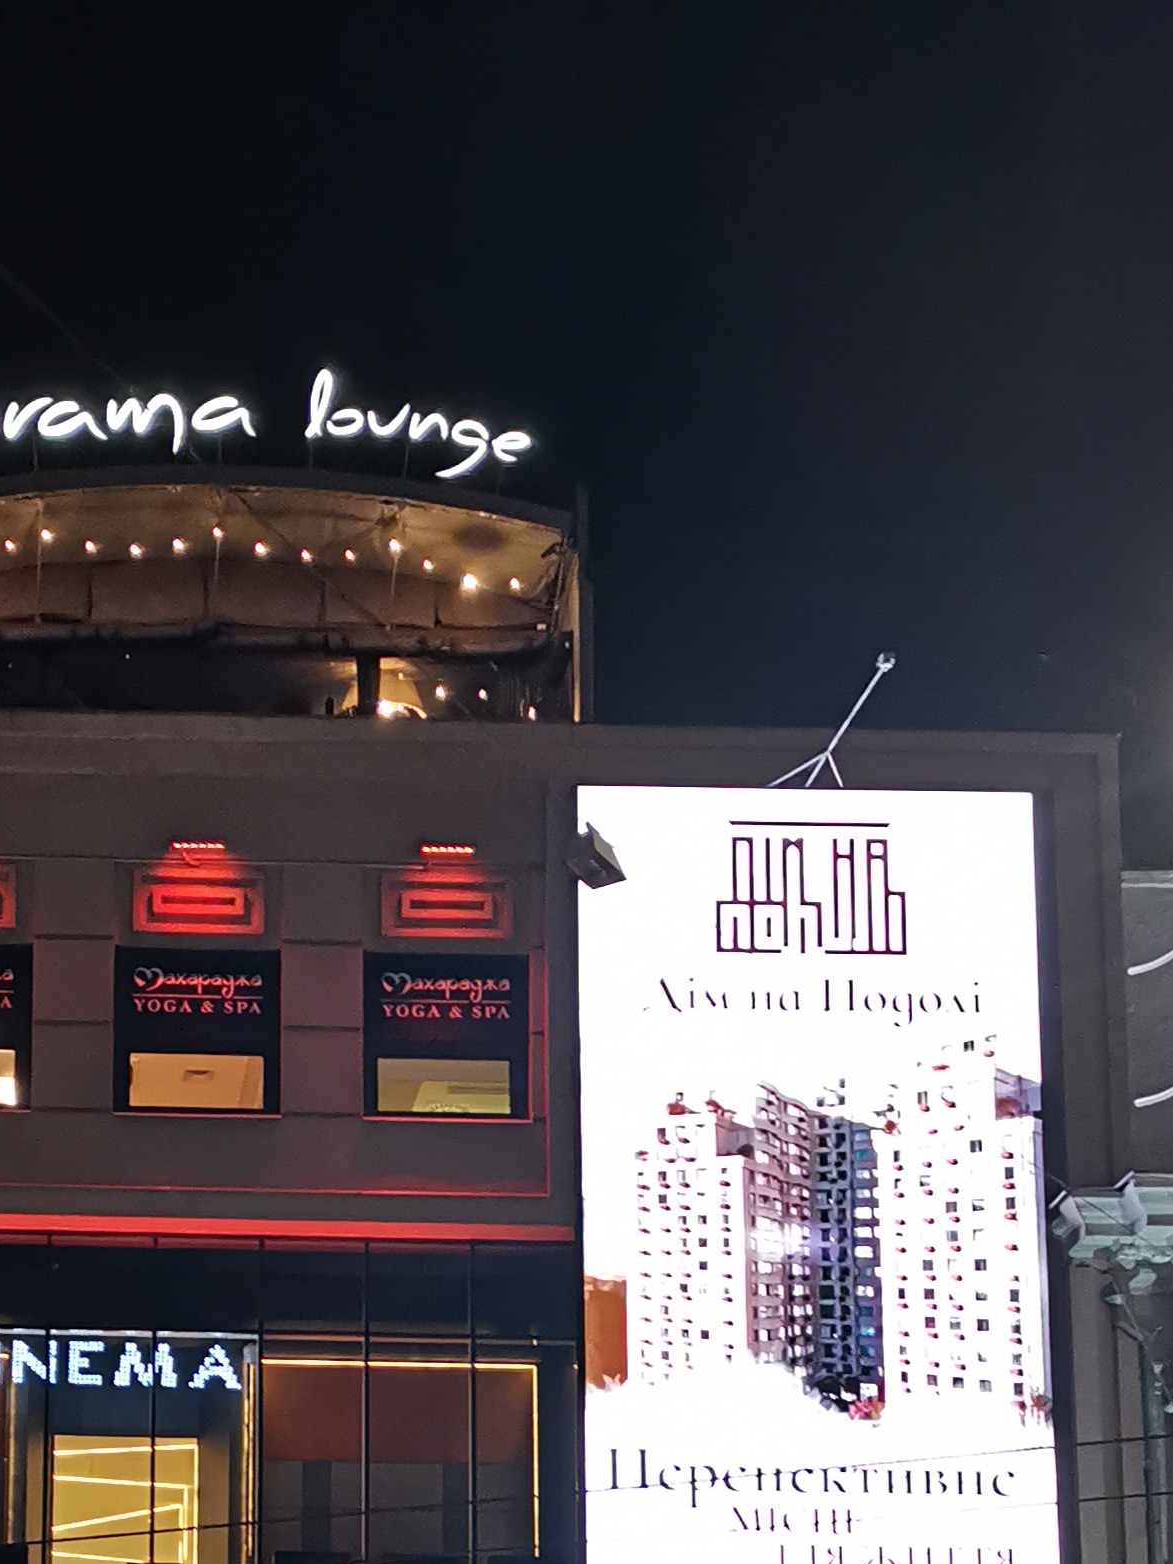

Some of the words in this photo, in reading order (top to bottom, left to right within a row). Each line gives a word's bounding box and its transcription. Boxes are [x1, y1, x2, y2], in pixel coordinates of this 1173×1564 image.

[303, 368, 533, 478] lounge
[133, 998, 192, 1013] YOGA
[200, 1000, 214, 1013] &
[223, 1000, 262, 1015] SPA
[382, 1003, 441, 1018] YOGA
[448, 1005, 463, 1018] &
[471, 1004, 510, 1019] SPA
